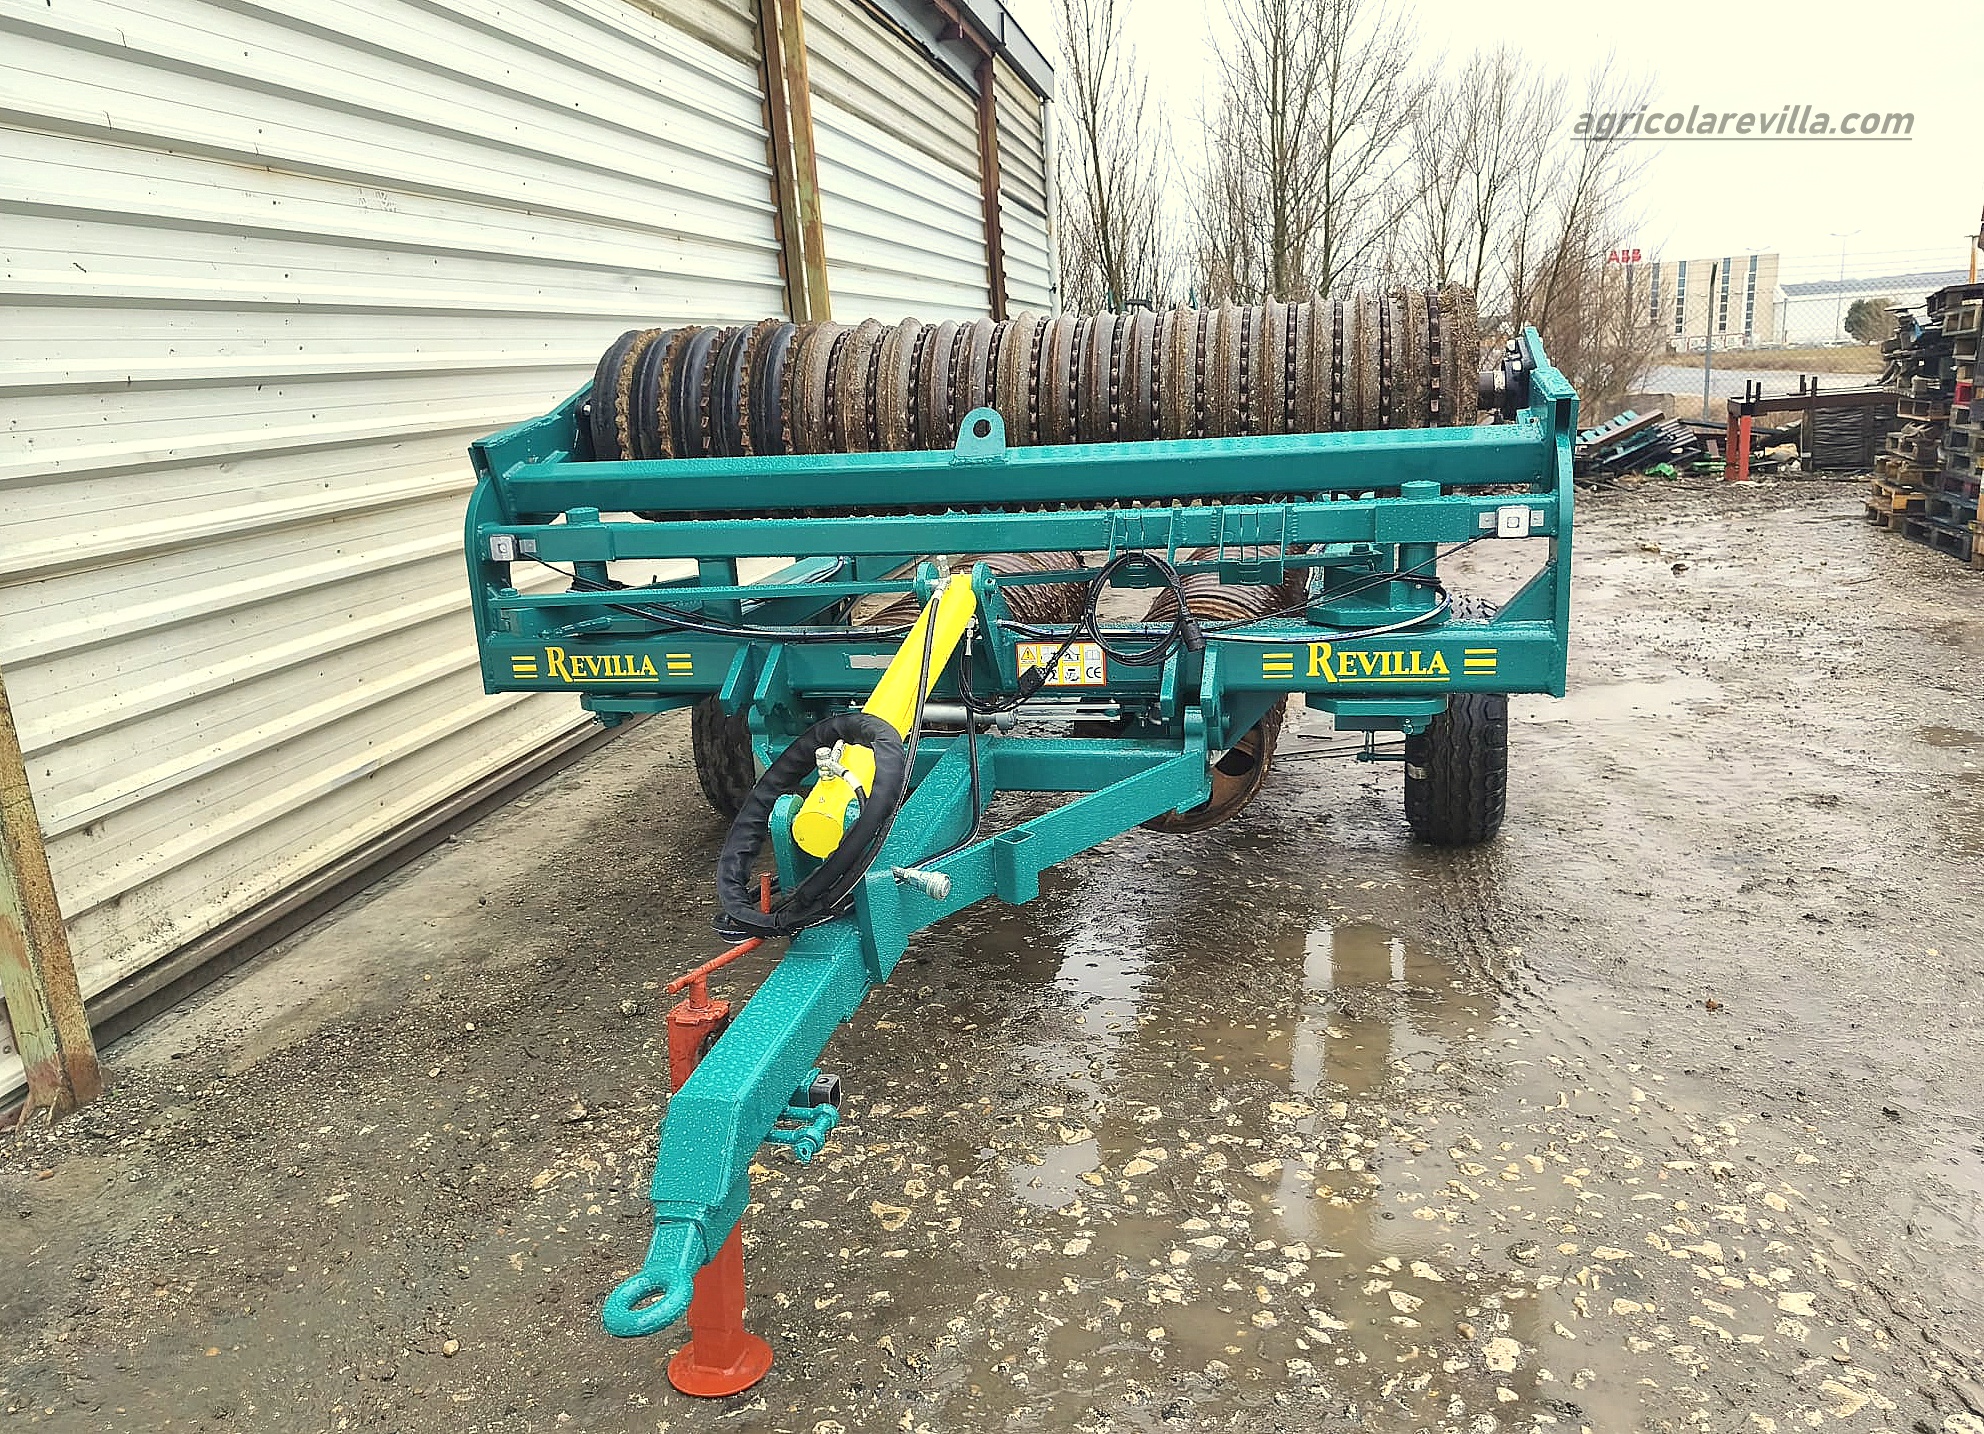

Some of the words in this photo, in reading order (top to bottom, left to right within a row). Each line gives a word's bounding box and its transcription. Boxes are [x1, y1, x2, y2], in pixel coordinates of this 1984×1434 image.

[1607, 249, 1642, 263] ABB
[544, 646, 659, 683] REVILLA
[1086, 666, 1102, 679] CE
[1306, 642, 1450, 683] REVILLA
